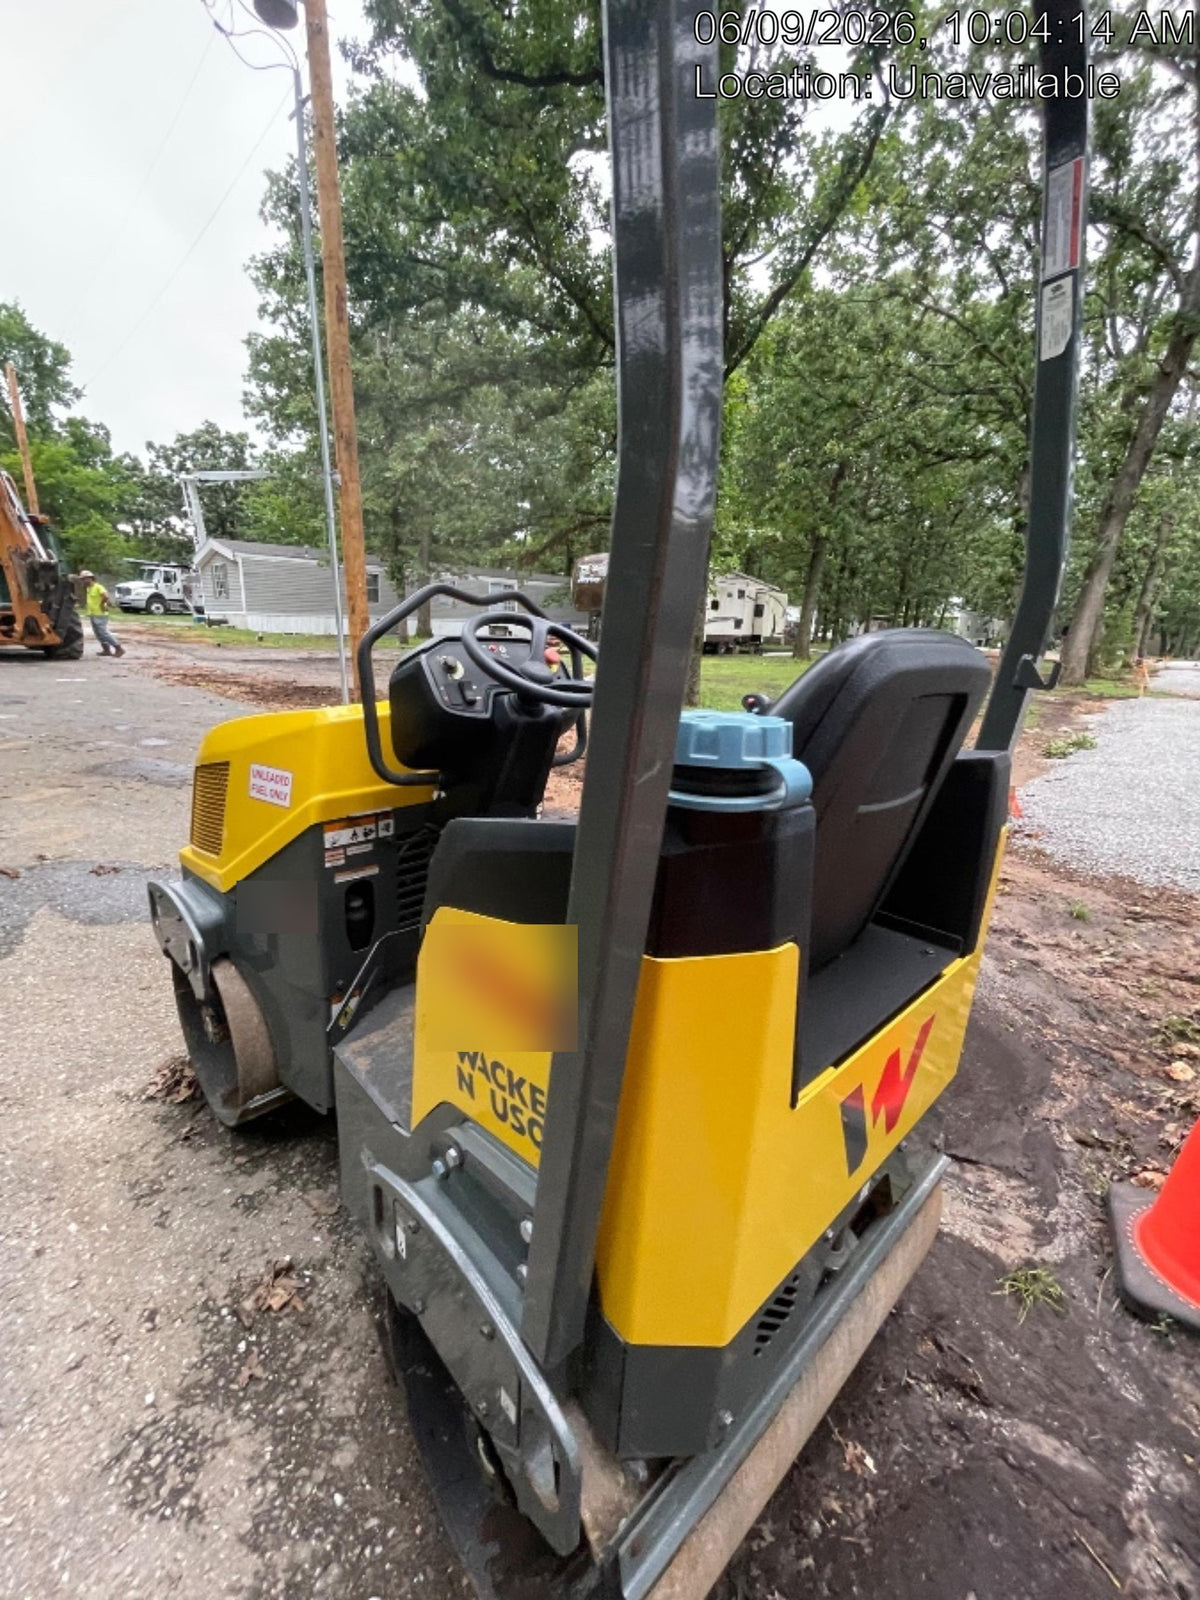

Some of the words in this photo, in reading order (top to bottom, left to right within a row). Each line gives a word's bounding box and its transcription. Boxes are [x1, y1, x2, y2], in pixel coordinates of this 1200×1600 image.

[252, 768, 289, 786] UNLEADED
[252, 783, 268, 797] FUEL
[270, 788, 288, 802] ONLY
